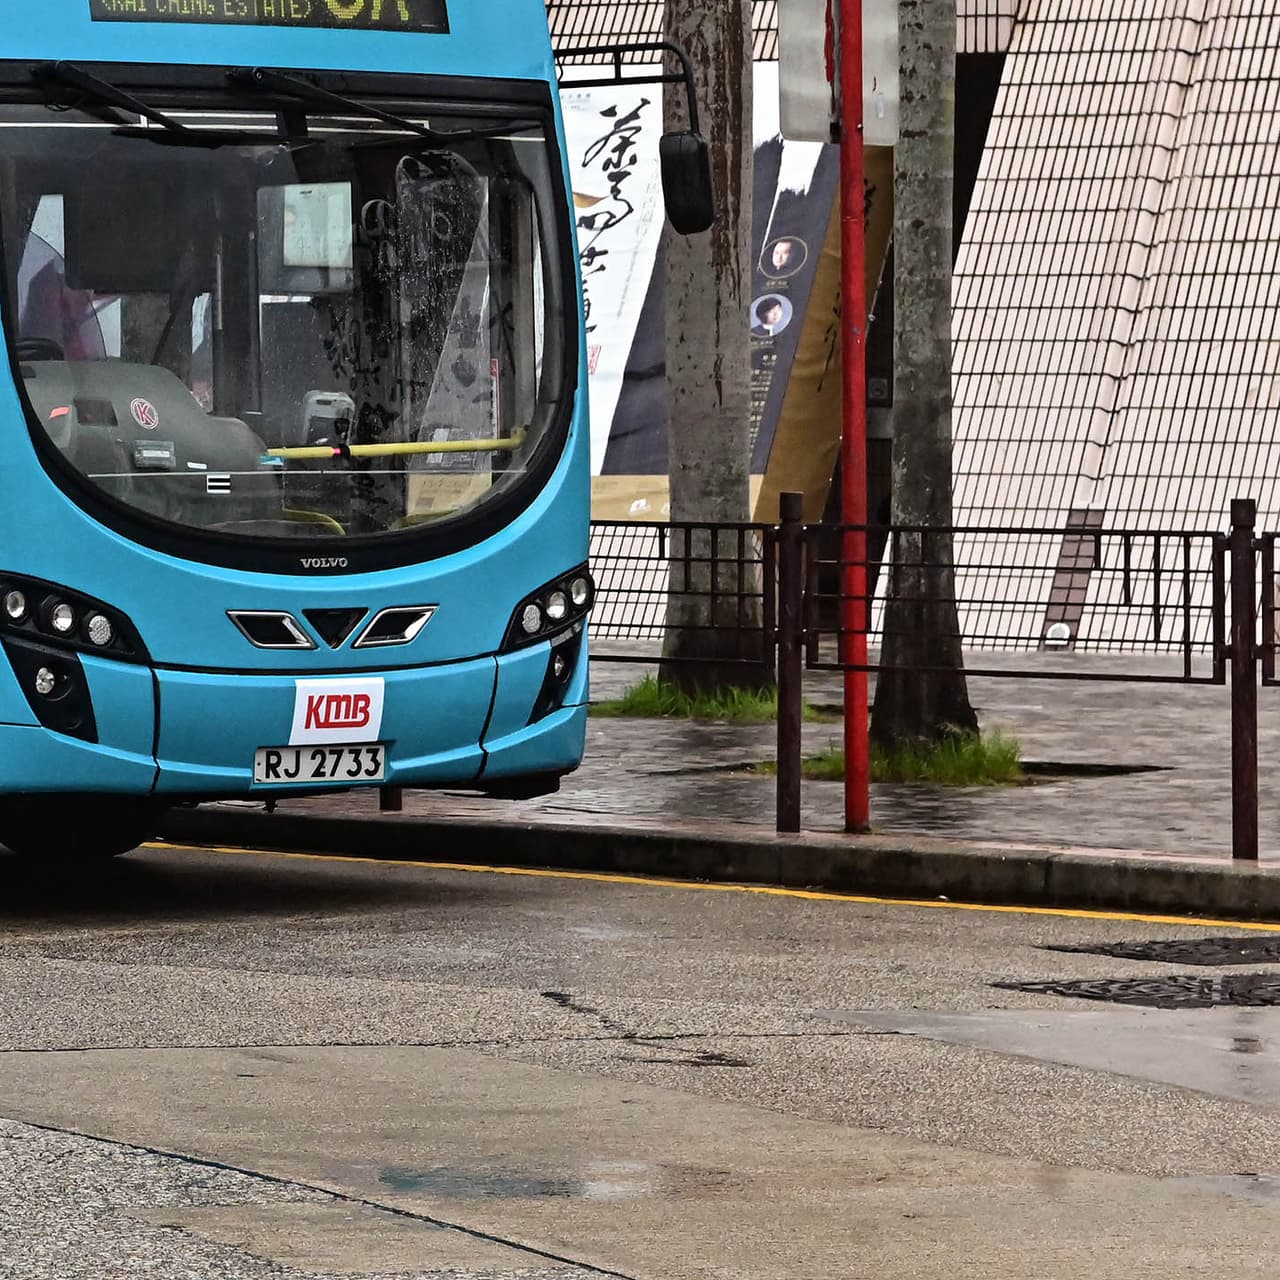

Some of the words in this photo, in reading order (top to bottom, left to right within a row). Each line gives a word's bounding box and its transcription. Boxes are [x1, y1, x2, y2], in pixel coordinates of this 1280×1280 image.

[300, 557, 348, 568] VOLVO
[305, 694, 371, 729] KMB
[265, 750, 300, 779] RJ
[310, 748, 381, 778] 2733
